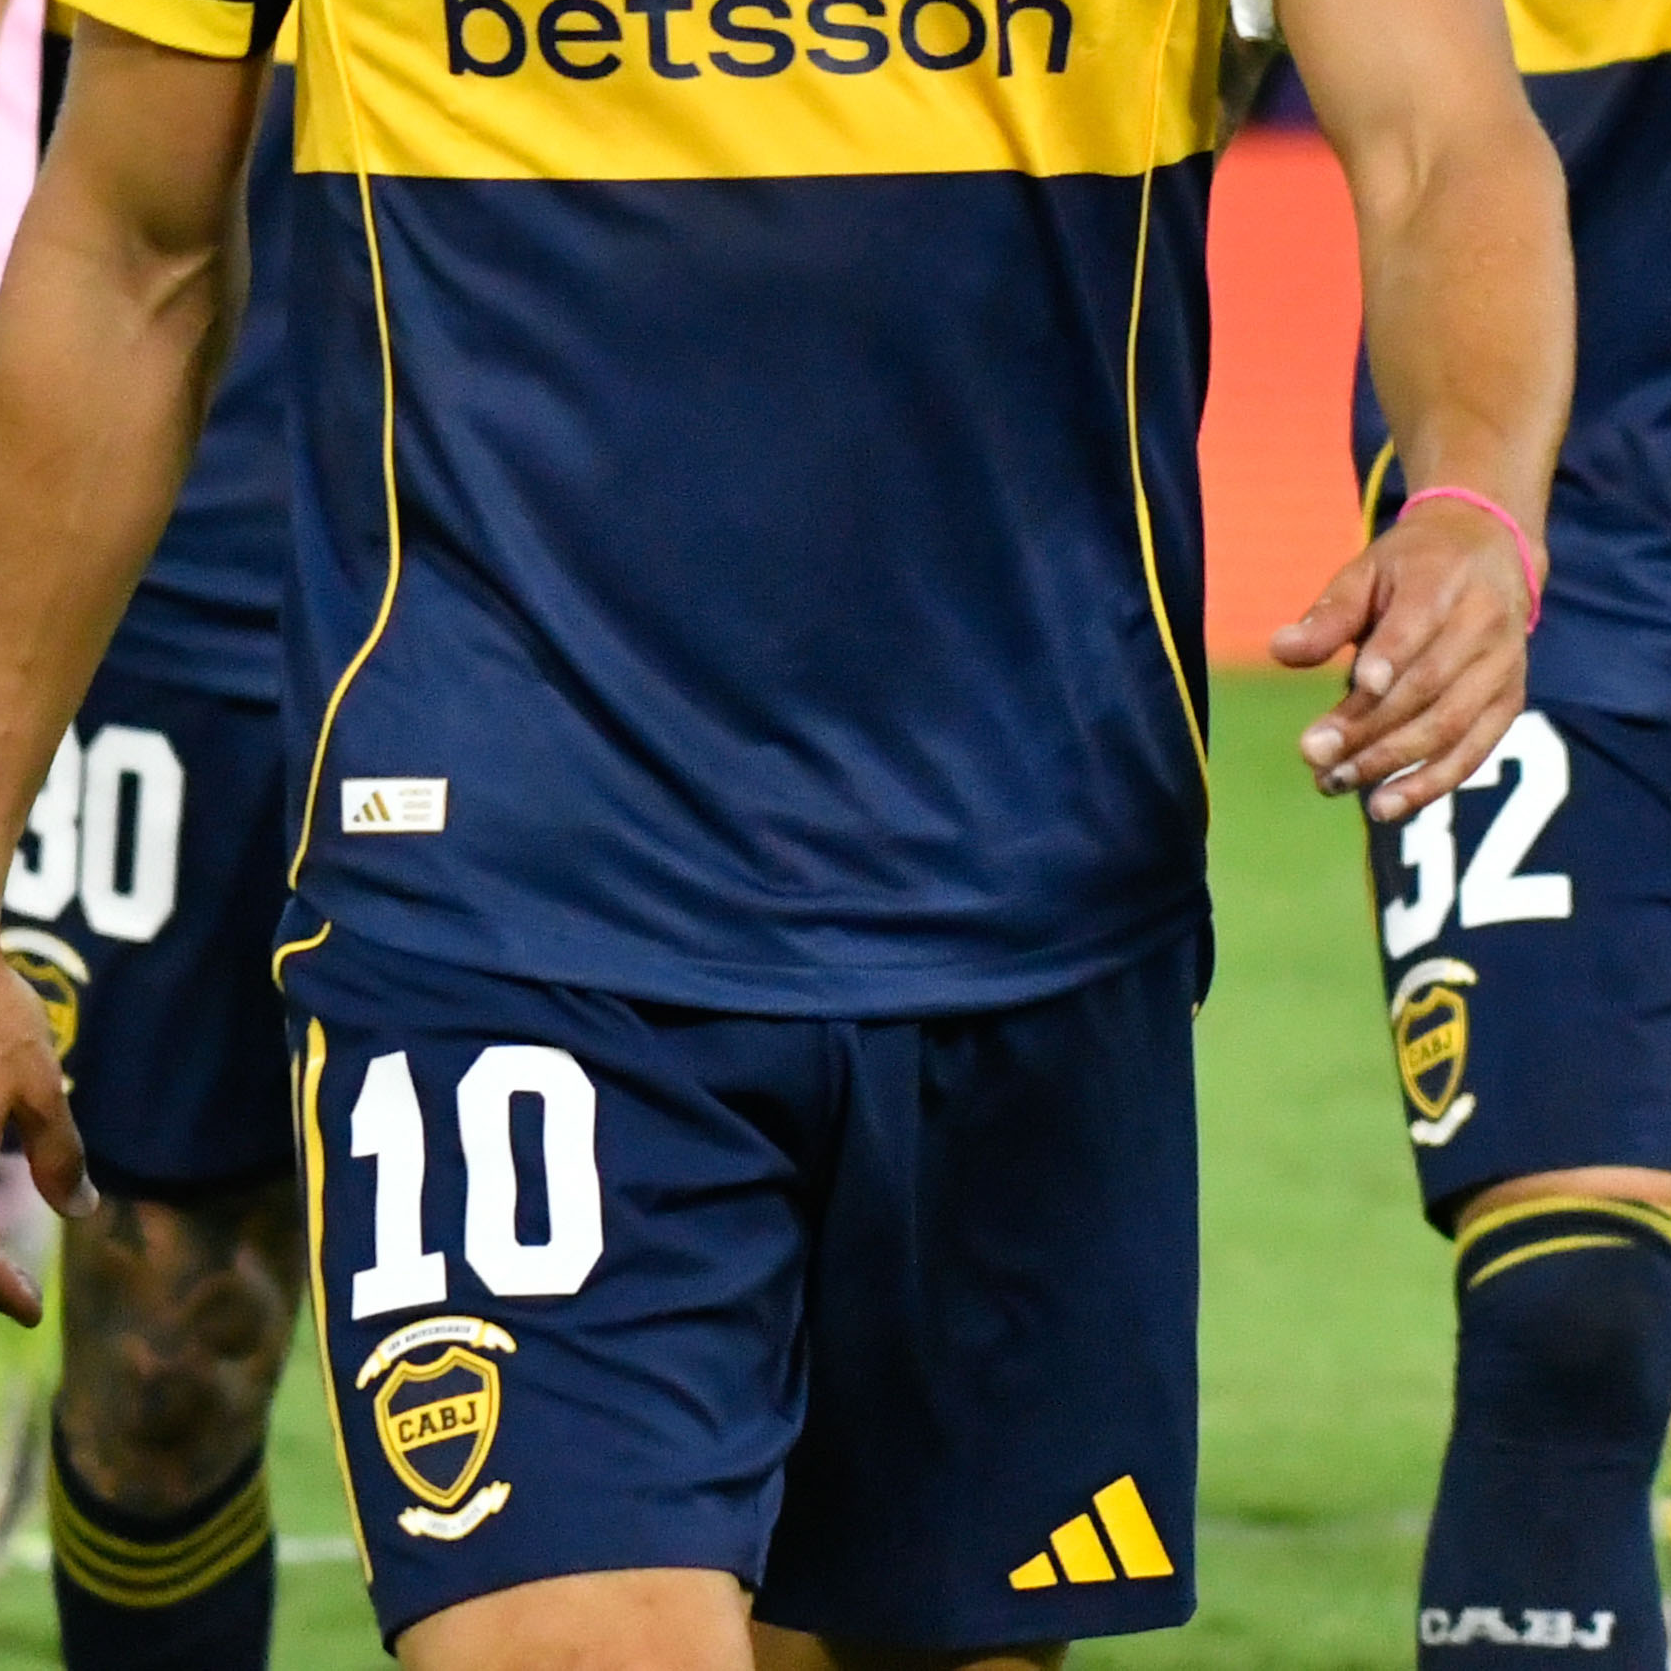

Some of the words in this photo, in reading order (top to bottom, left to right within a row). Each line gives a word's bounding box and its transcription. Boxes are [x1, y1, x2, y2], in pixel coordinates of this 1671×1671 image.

[1382, 708, 1573, 961] 32
[350, 1044, 604, 1321] 10
[398, 1401, 477, 1444] CABJ
[1419, 1605, 1617, 1651] CABJ
